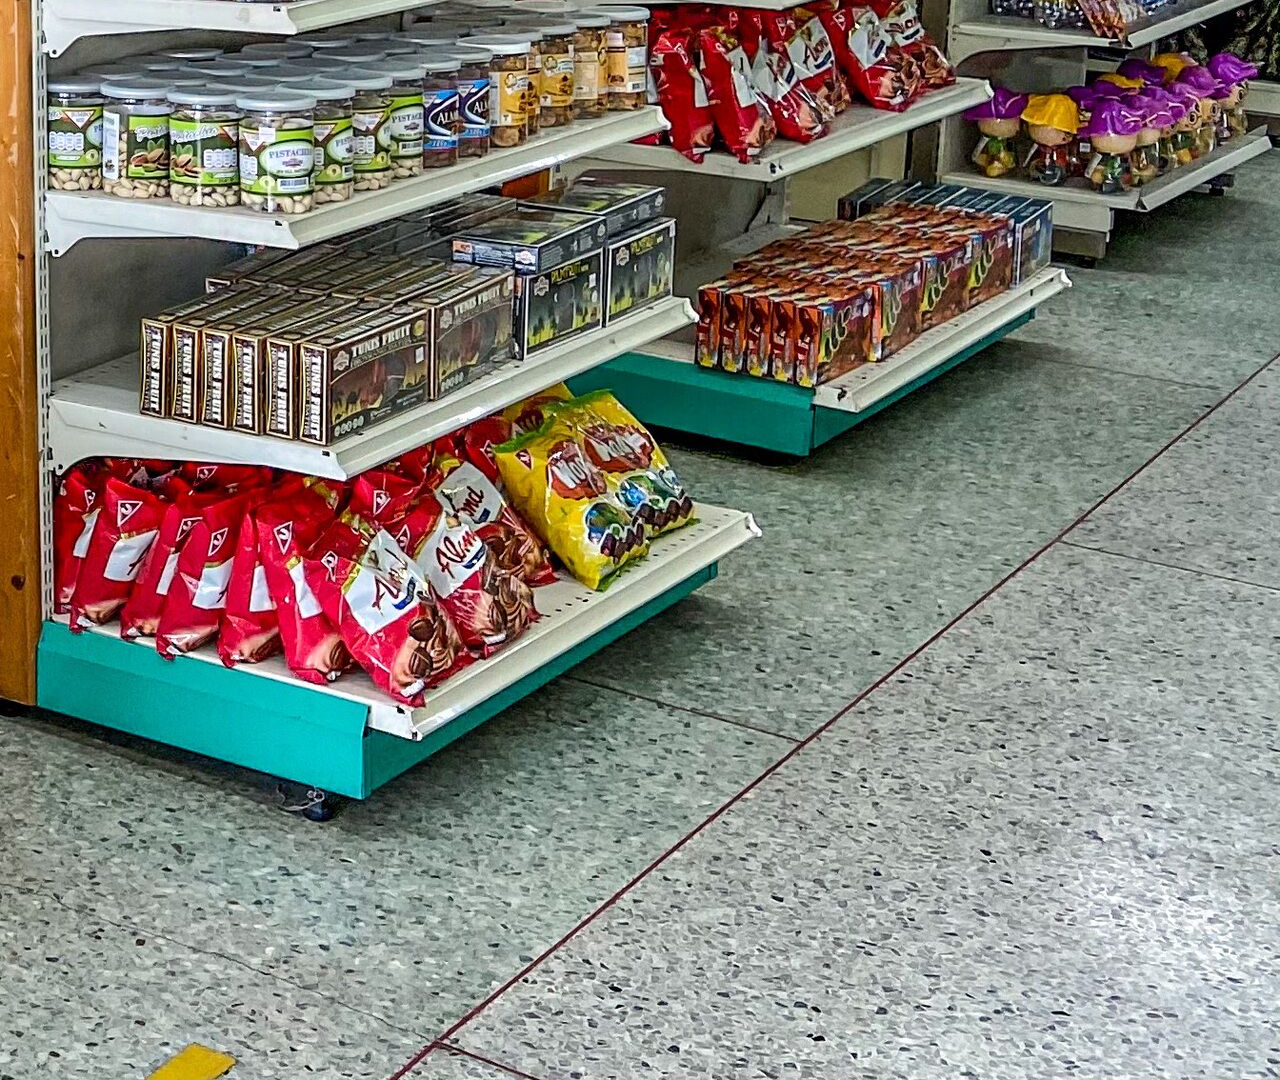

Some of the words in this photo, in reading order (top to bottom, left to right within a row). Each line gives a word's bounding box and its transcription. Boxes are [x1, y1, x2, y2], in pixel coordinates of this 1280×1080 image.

[151, 330, 161, 369] TUNIS
[183, 336, 192, 374] TUNIS
[213, 341, 223, 379] TUNIS
[351, 337, 380, 357] TUNIS
[382, 326, 411, 345] FRUIT
[243, 347, 253, 384] TUNIS
[278, 350, 287, 389] TUNIS
[312, 356, 322, 394] TUNIS
[151, 371, 160, 411] FRUIT
[182, 377, 191, 415] FRUIT
[212, 382, 222, 422] FRUIT
[243, 387, 253, 427] FRUIT
[278, 391, 287, 432] FRUIT
[311, 397, 321, 438] FRUIT
